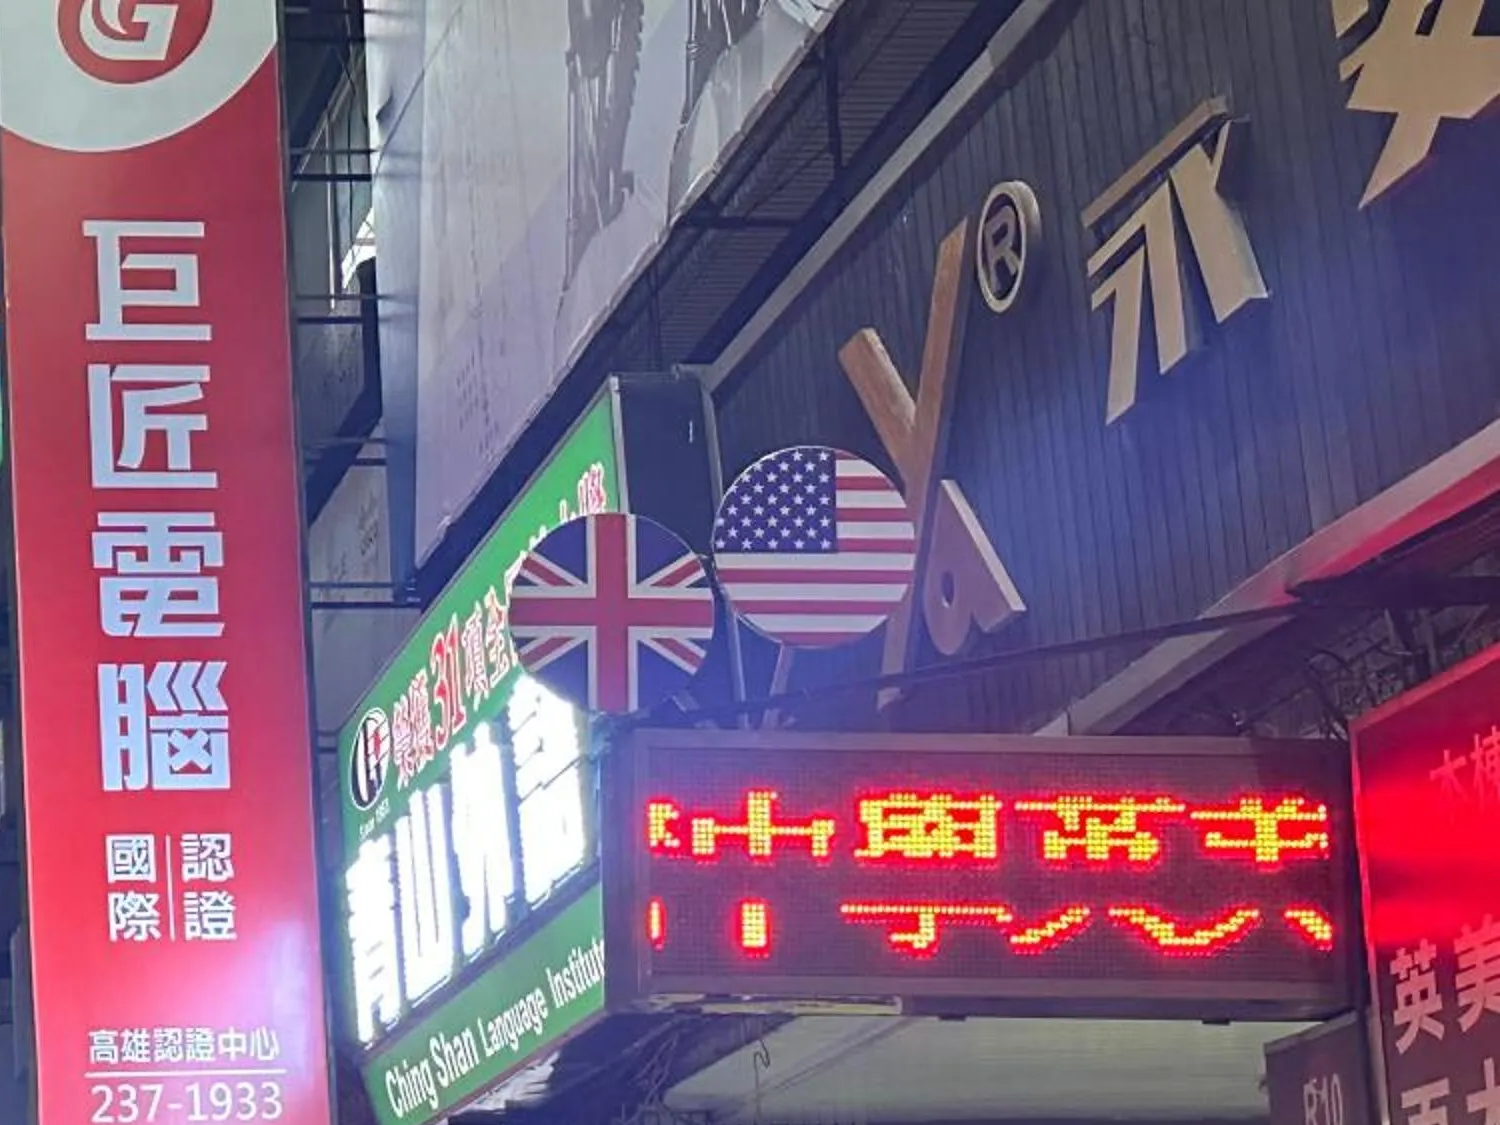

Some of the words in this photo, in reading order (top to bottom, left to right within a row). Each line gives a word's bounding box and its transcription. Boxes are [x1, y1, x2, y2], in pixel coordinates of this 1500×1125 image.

[83, 219, 231, 791] 巨匠電腦
[105, 833, 162, 943] 國際
[180, 832, 238, 941] 認證
[88, 1026, 280, 1065] 高雄認證中心
[385, 1058, 436, 1120] Ching
[429, 1027, 479, 1088] Shan
[477, 986, 549, 1058] Language
[91, 1080, 283, 1124] 237-1933
